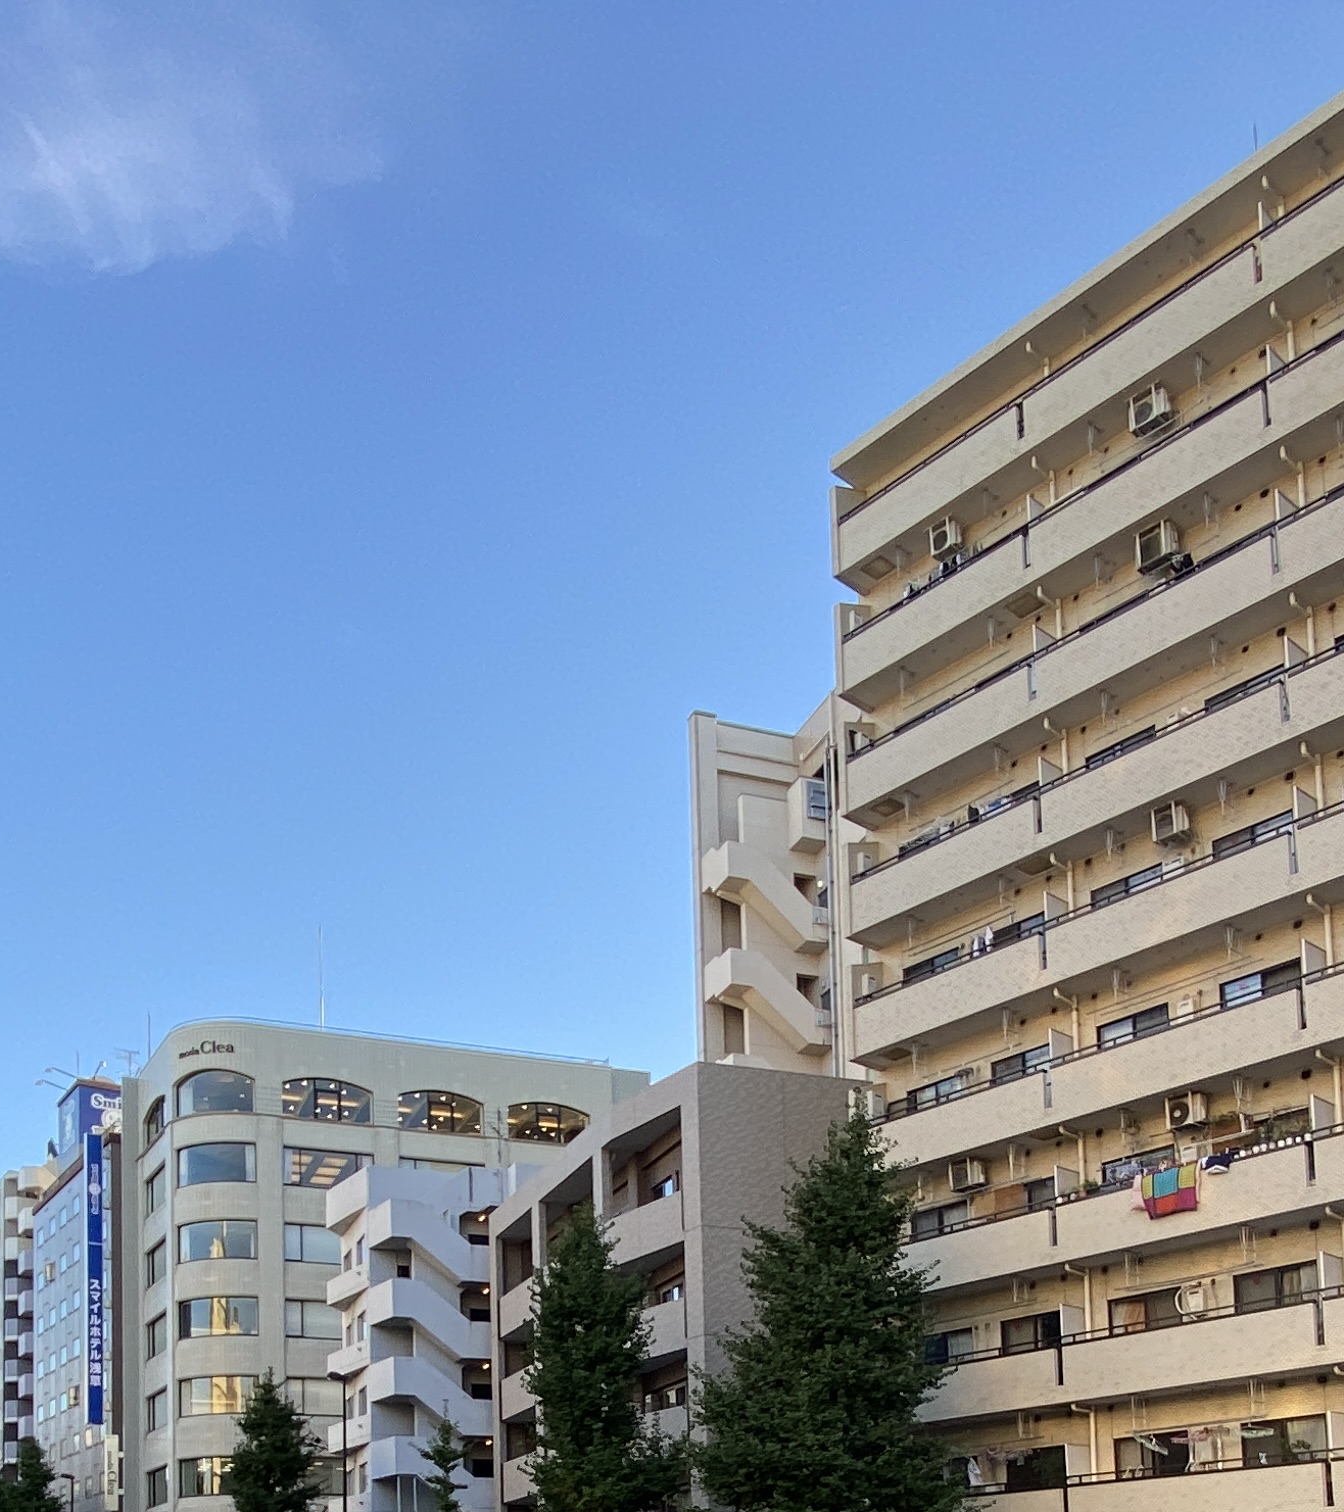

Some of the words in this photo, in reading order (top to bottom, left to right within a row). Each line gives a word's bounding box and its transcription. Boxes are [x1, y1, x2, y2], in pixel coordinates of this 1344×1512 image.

[200, 1040, 235, 1055] Clea
[89, 1278, 102, 1387] スマイルホテル浅草
